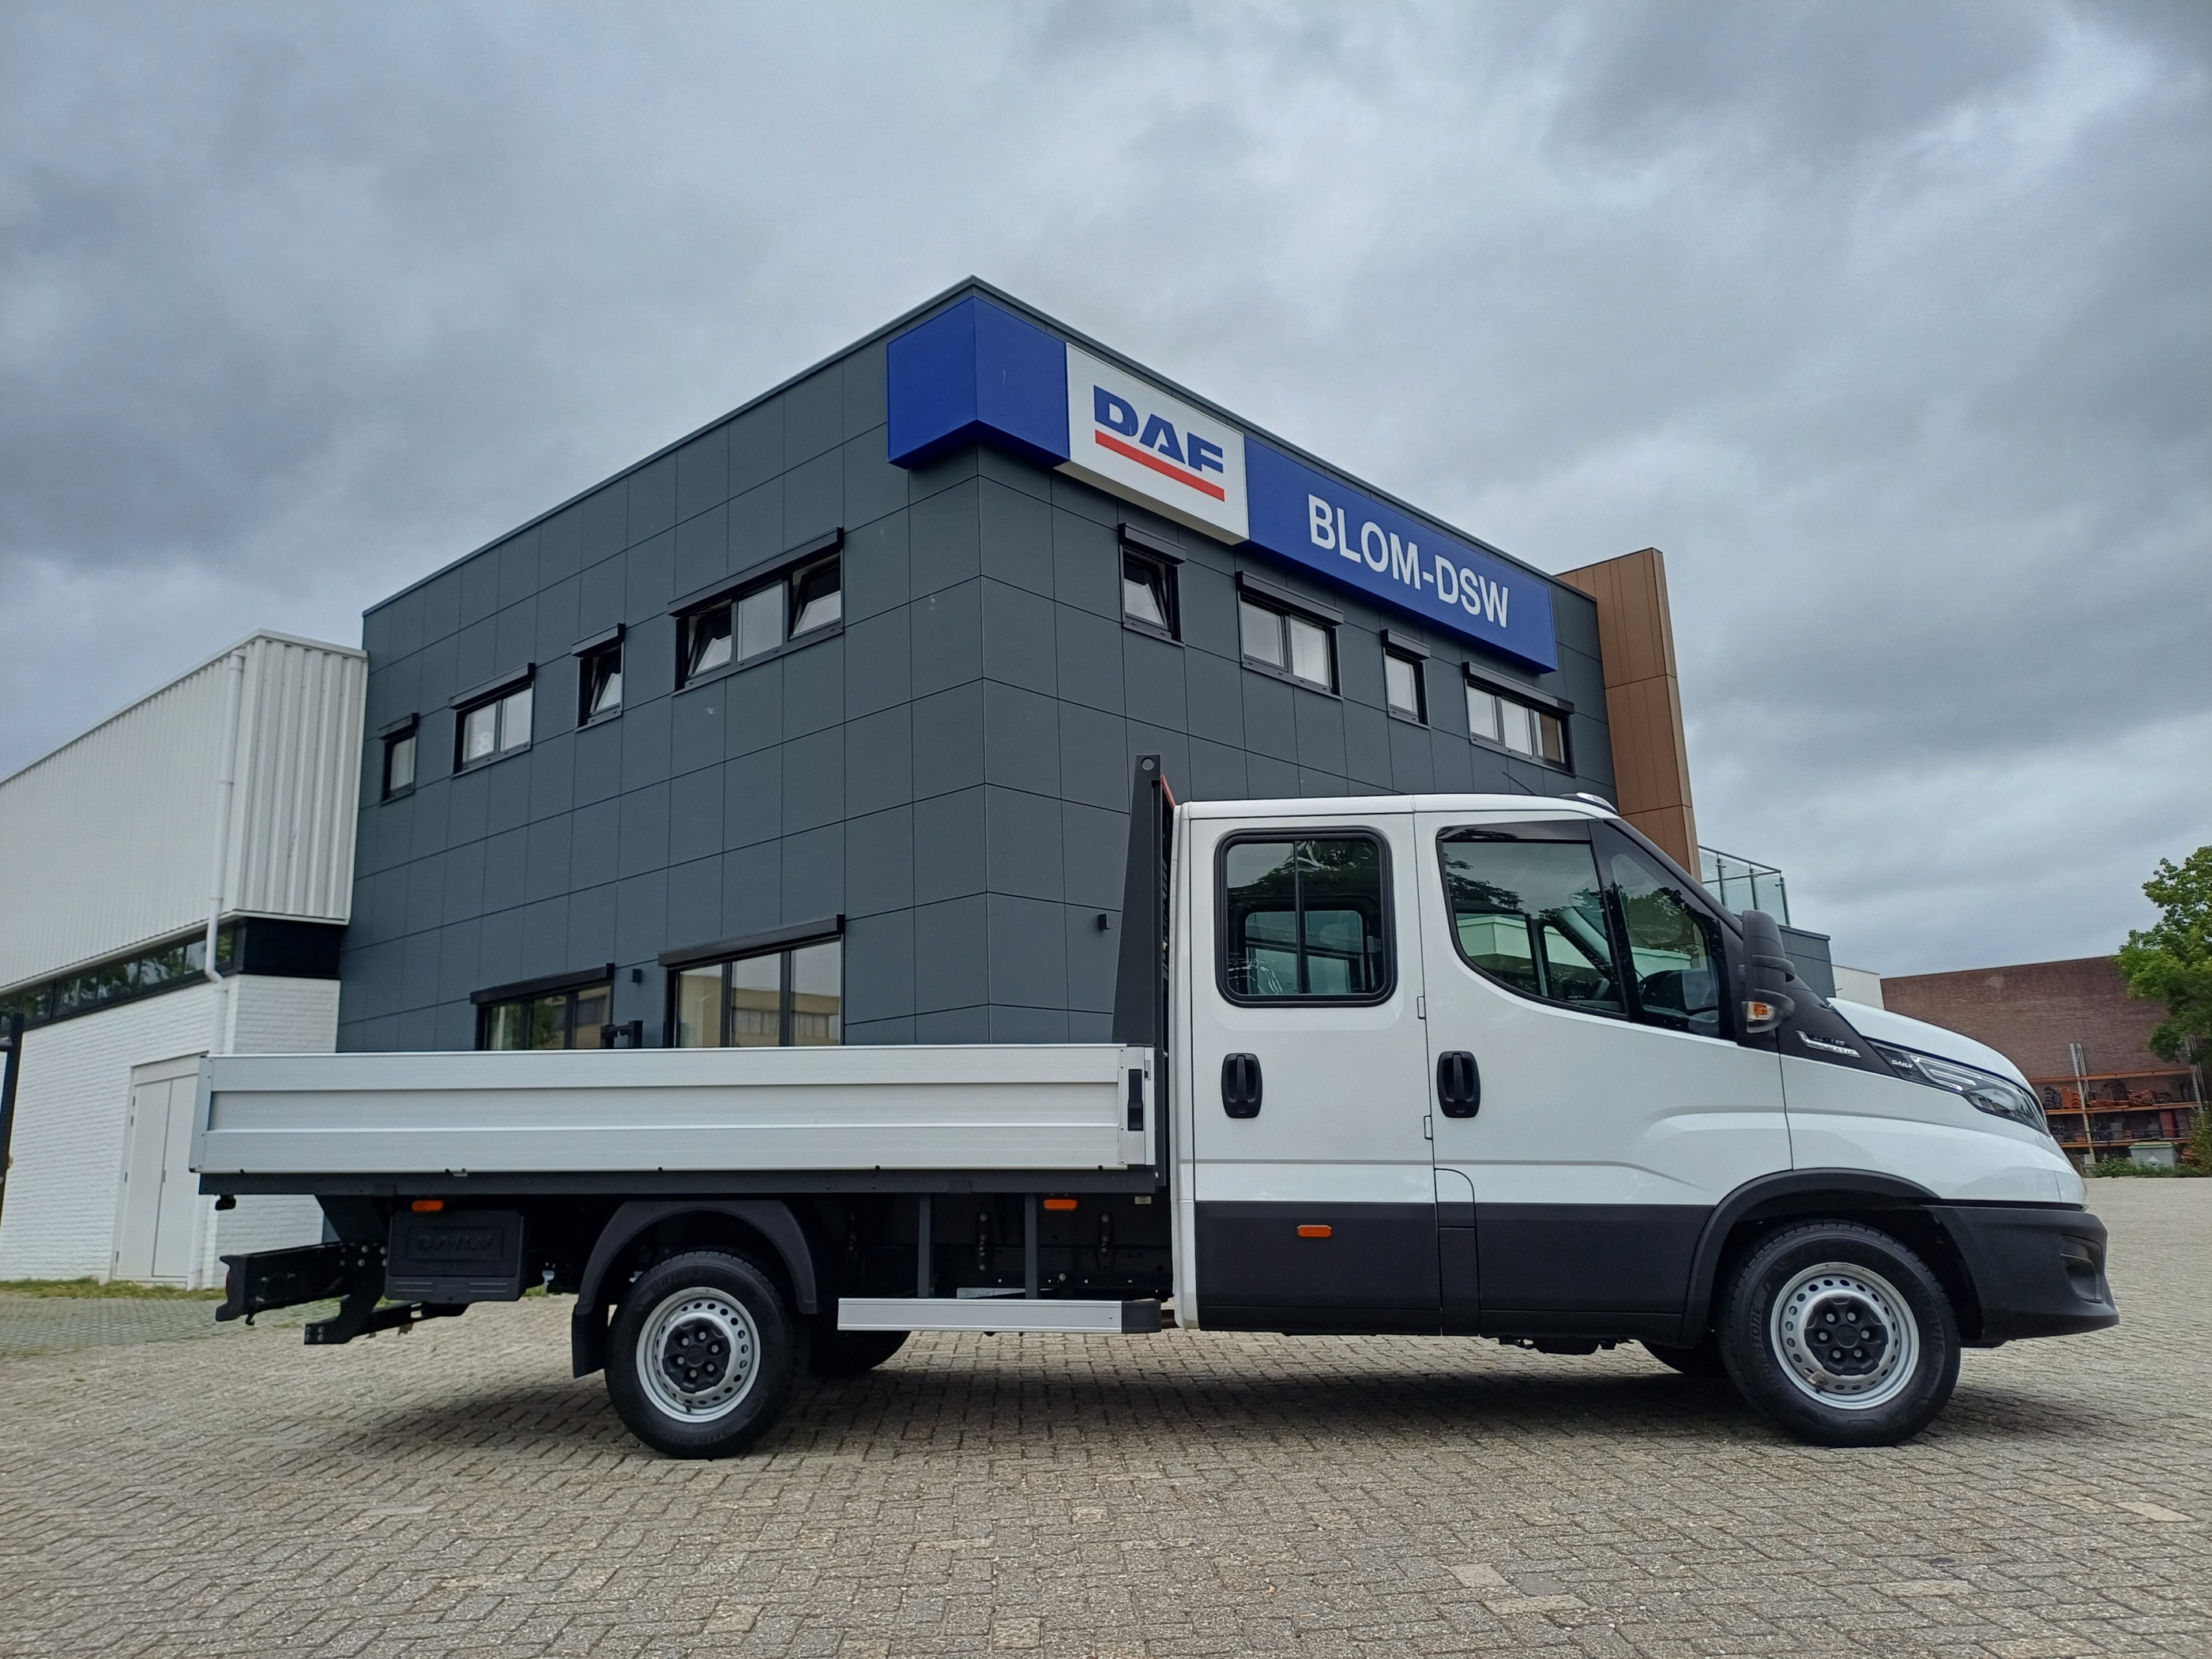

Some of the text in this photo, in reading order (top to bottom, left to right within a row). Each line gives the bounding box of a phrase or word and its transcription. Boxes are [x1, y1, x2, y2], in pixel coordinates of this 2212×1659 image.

[1093, 385, 1224, 474] DAF
[1307, 493, 1509, 629] BLOM-DSW
[1891, 1059, 1914, 1069] DAILY
[418, 1234, 492, 1250] DAILY
